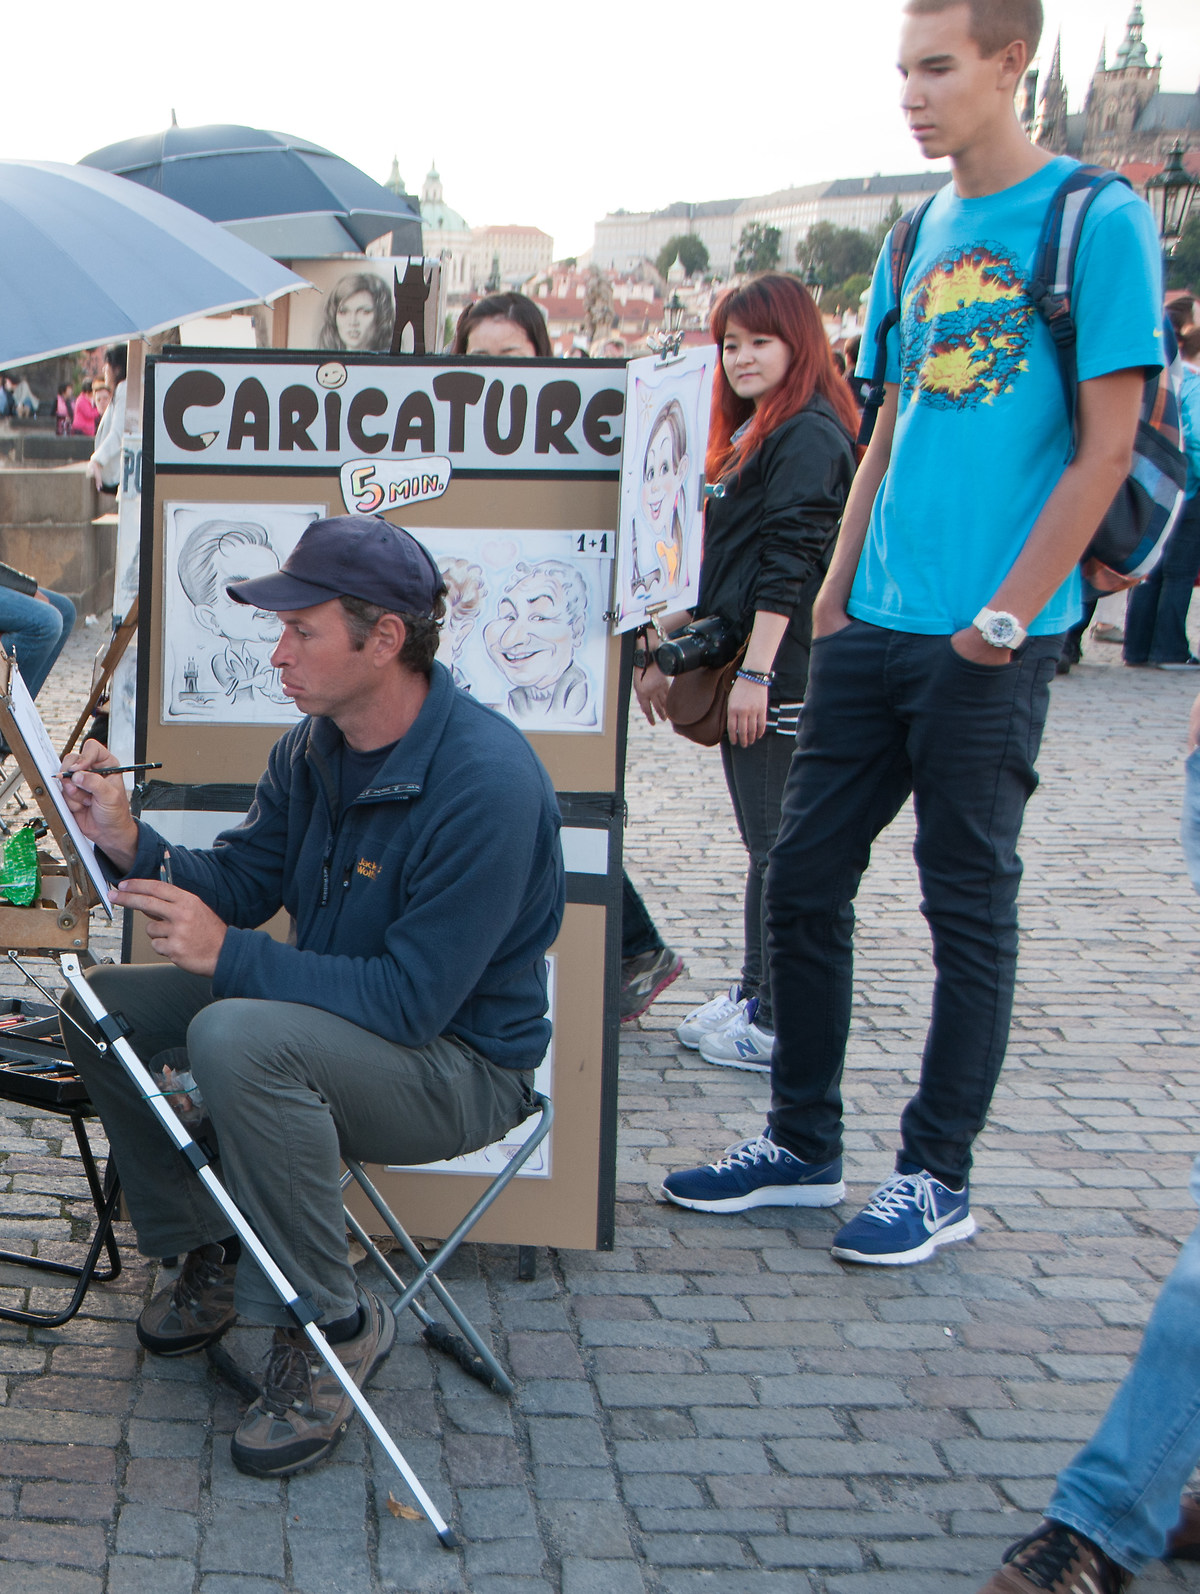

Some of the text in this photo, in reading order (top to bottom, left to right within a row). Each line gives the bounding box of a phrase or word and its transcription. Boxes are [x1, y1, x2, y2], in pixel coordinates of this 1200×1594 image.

[163, 369, 625, 456] CARICATURE
[351, 465, 444, 513] 5 MIN.
[577, 533, 608, 553] 1+1
